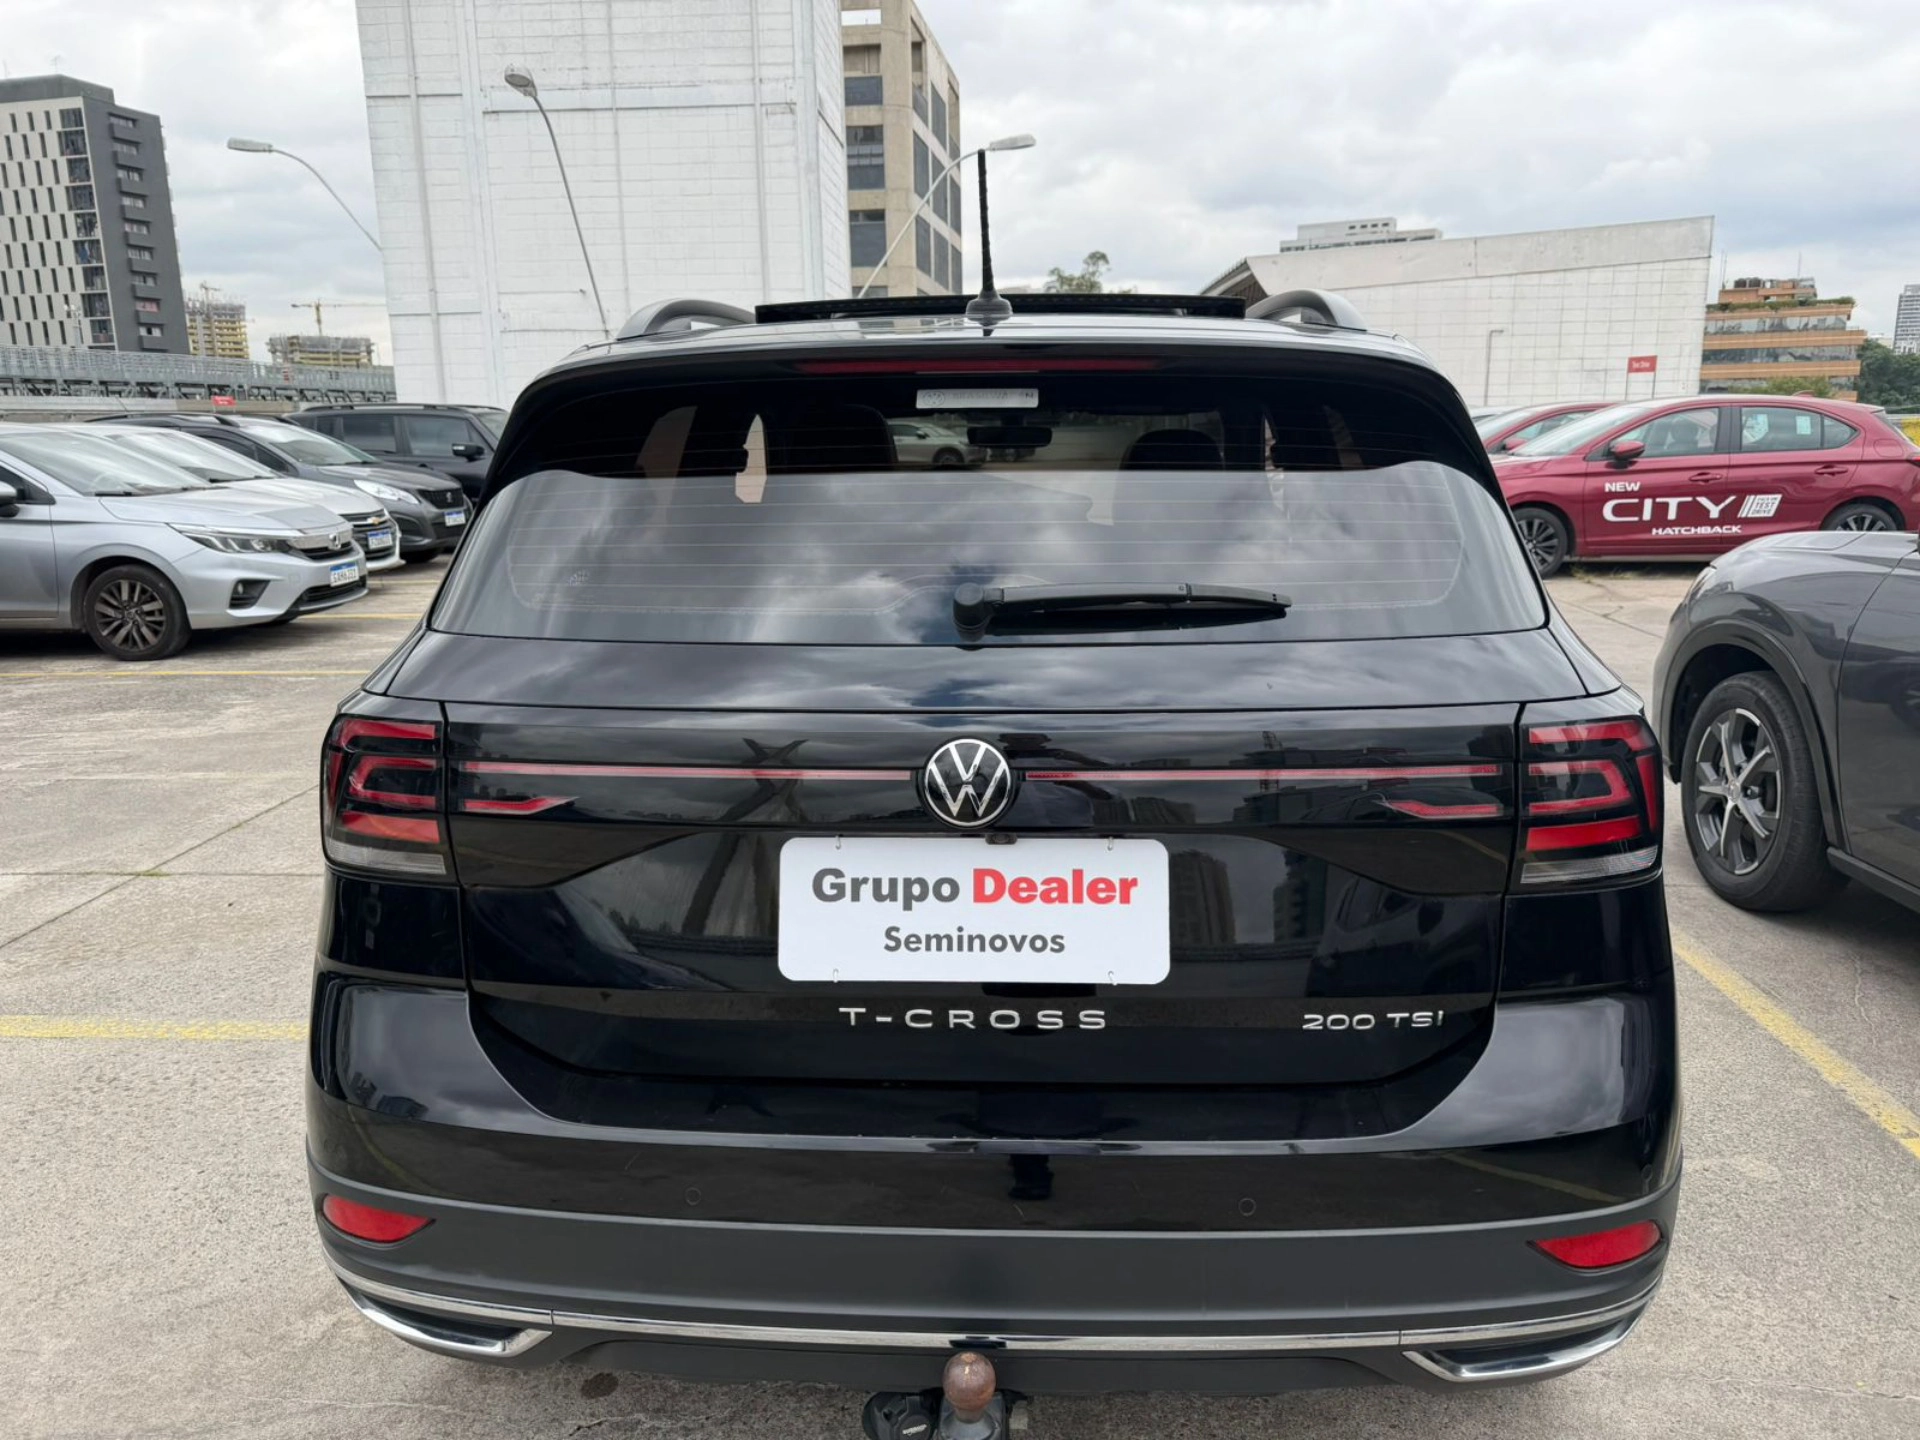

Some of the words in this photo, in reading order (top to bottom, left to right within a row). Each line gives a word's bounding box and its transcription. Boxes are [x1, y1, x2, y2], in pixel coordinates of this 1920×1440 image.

[1604, 481, 1641, 493] NEW
[1602, 495, 1737, 522] CITY
[1651, 524, 1742, 536] HATCHBACK
[811, 867, 961, 911] Grupo
[972, 868, 1139, 905] Dealer
[883, 925, 1066, 954] Seminovos
[838, 1006, 1107, 1030] T-CROSS
[1302, 1013, 1376, 1030] 200
[1386, 1010, 1445, 1028] TSI
